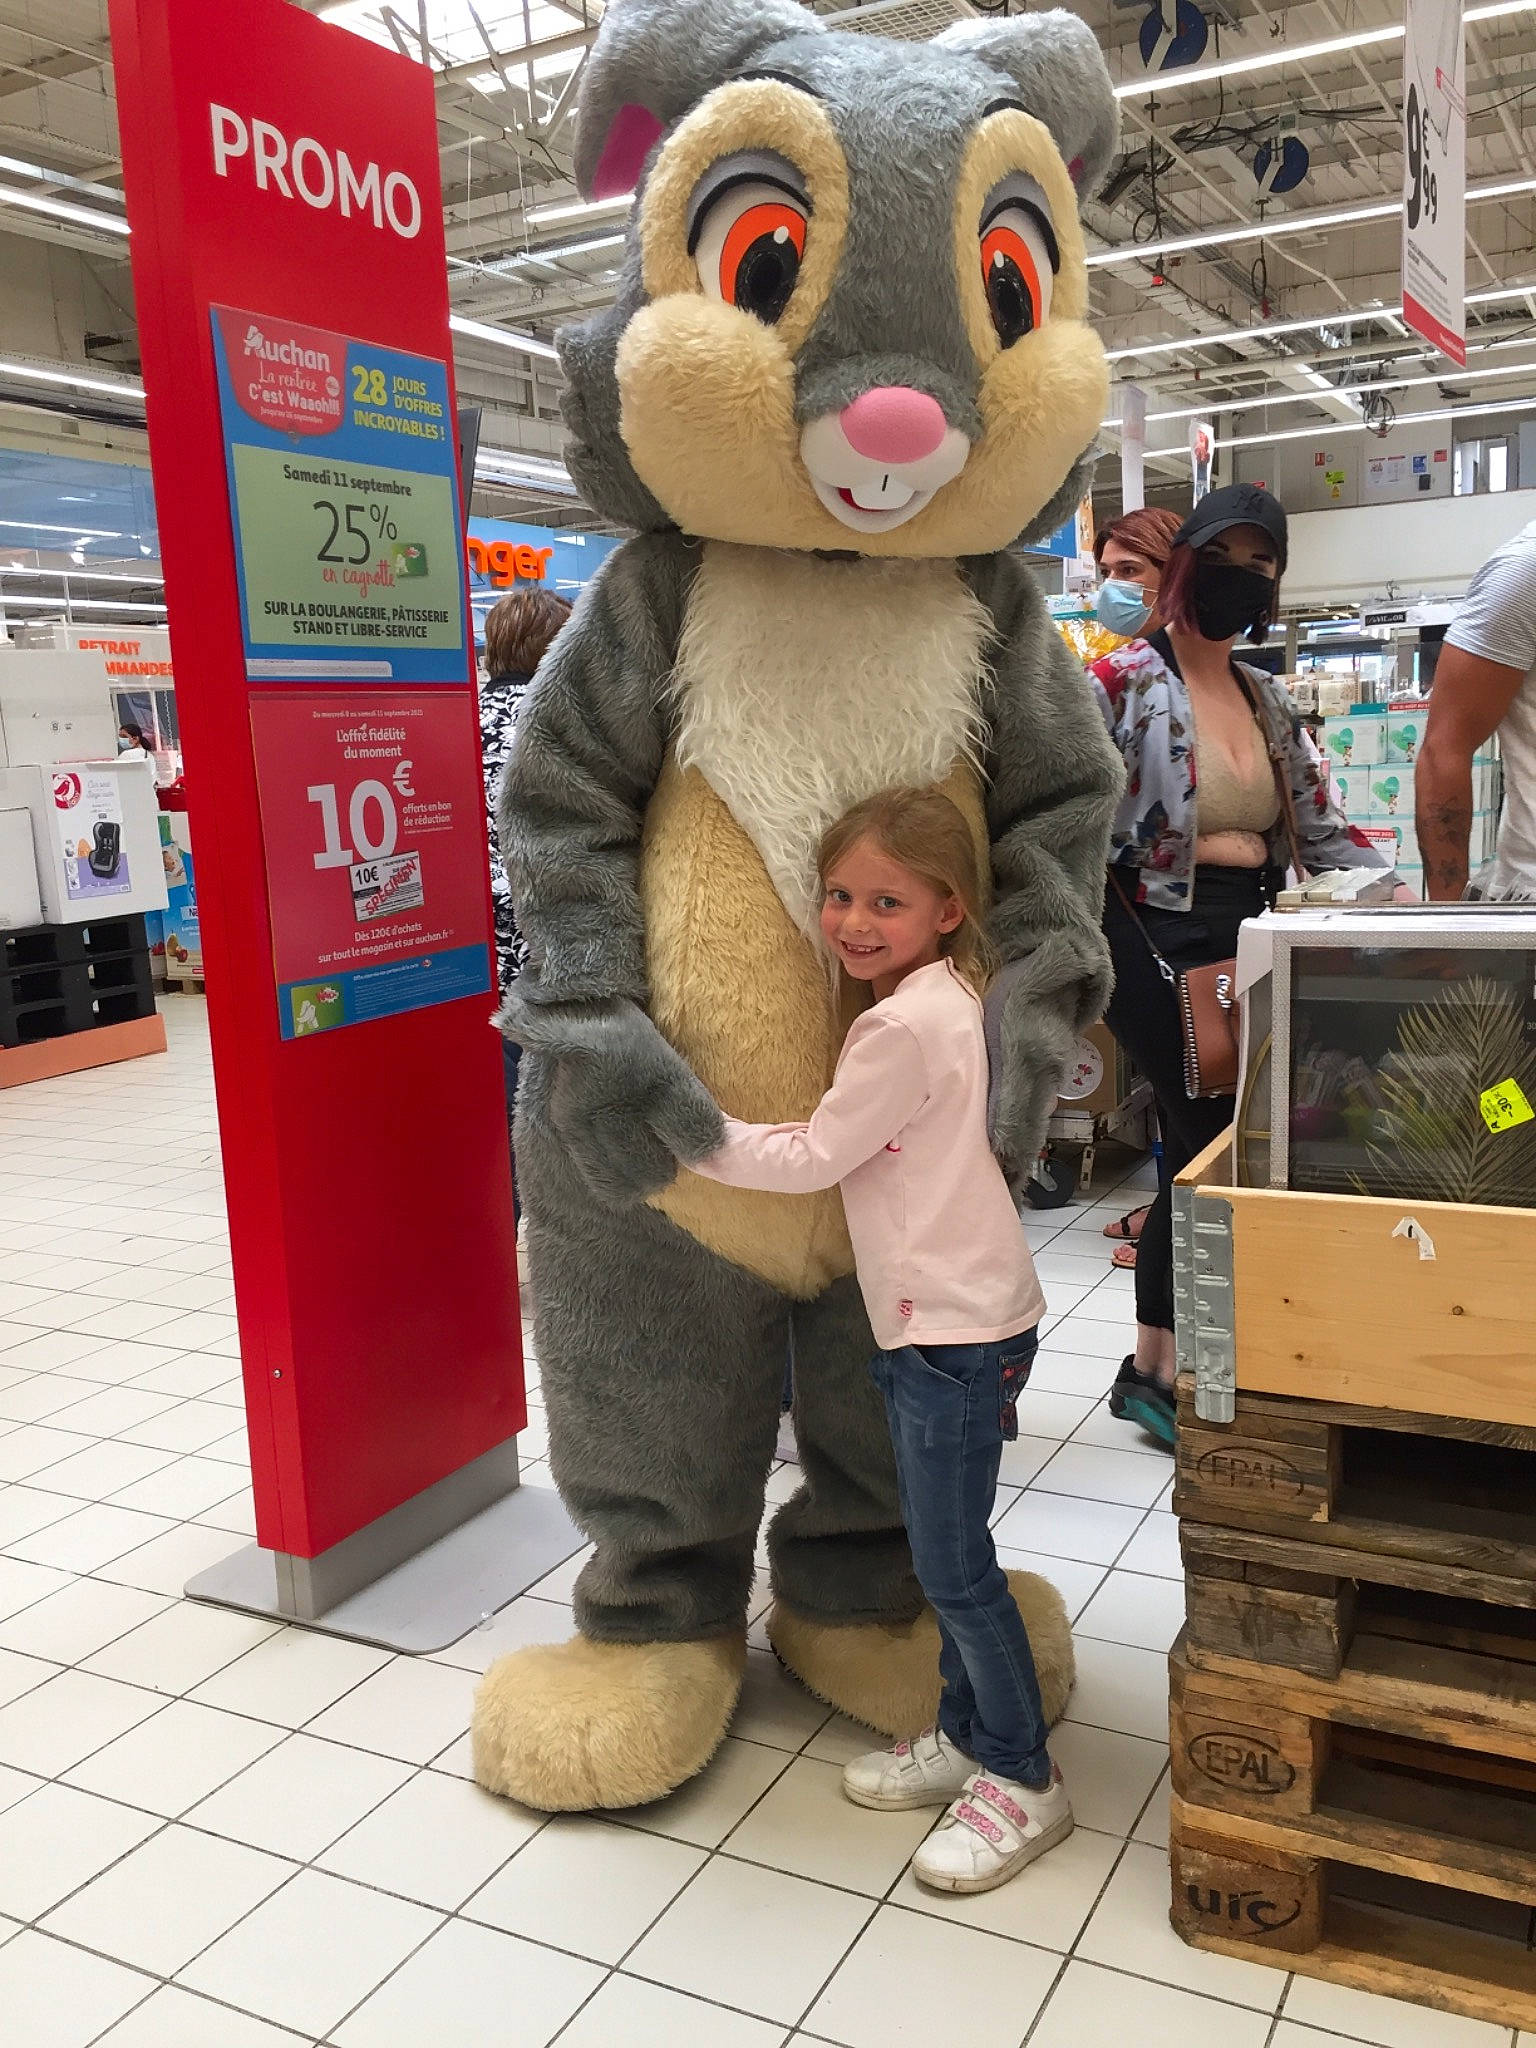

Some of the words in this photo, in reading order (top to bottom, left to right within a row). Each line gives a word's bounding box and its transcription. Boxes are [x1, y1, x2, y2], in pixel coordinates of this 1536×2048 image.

[210, 102, 421, 239] PROMO
[243, 325, 331, 372] Auchan
[259, 360, 276, 384] La
[352, 365, 387, 406] 28
[392, 376, 427, 396] JOURS
[248, 382, 285, 405] C'est
[394, 393, 443, 417] D'OFFRES
[353, 409, 439, 440] INCROYABLES
[283, 463, 332, 485] Samedi
[332, 472, 348, 488] 11
[350, 477, 412, 497] septembre
[313, 500, 398, 565] 25%
[467, 536, 553, 587] nger
[322, 568, 338, 584] en
[342, 560, 396, 599] cagnotte
[264, 600, 290, 616] SUR
[290, 602, 307, 617] LA
[308, 602, 391, 622] BOULANGERIE,
[392, 604, 449, 624] PÂTISSERIE
[293, 620, 333, 636] STAND
[335, 622, 349, 636] ET
[350, 623, 429, 639] LIBRE-SERVICE
[336, 729, 368, 743] L'offre
[368, 727, 406, 741] fidélité
[344, 746, 358, 759] du
[359, 745, 402, 759] moment
[307, 760, 415, 870] 10€
[402, 803, 427, 814] offerts
[438, 801, 452, 810] bon
[403, 816, 414, 827] de
[414, 812, 451, 826] réduction
[355, 866, 380, 885] 10€
[365, 859, 417, 916] SPECIMEN
[354, 931, 371, 943] Dès
[371, 927, 391, 941] 120€
[392, 922, 422, 937] d'achats
[318, 954, 332, 964] sur
[333, 948, 351, 961] tout
[352, 947, 360, 957] le
[361, 939, 394, 957] magasin
[394, 937, 402, 948] et
[403, 937, 415, 946] sur
[415, 929, 449, 945] auchan.fr
